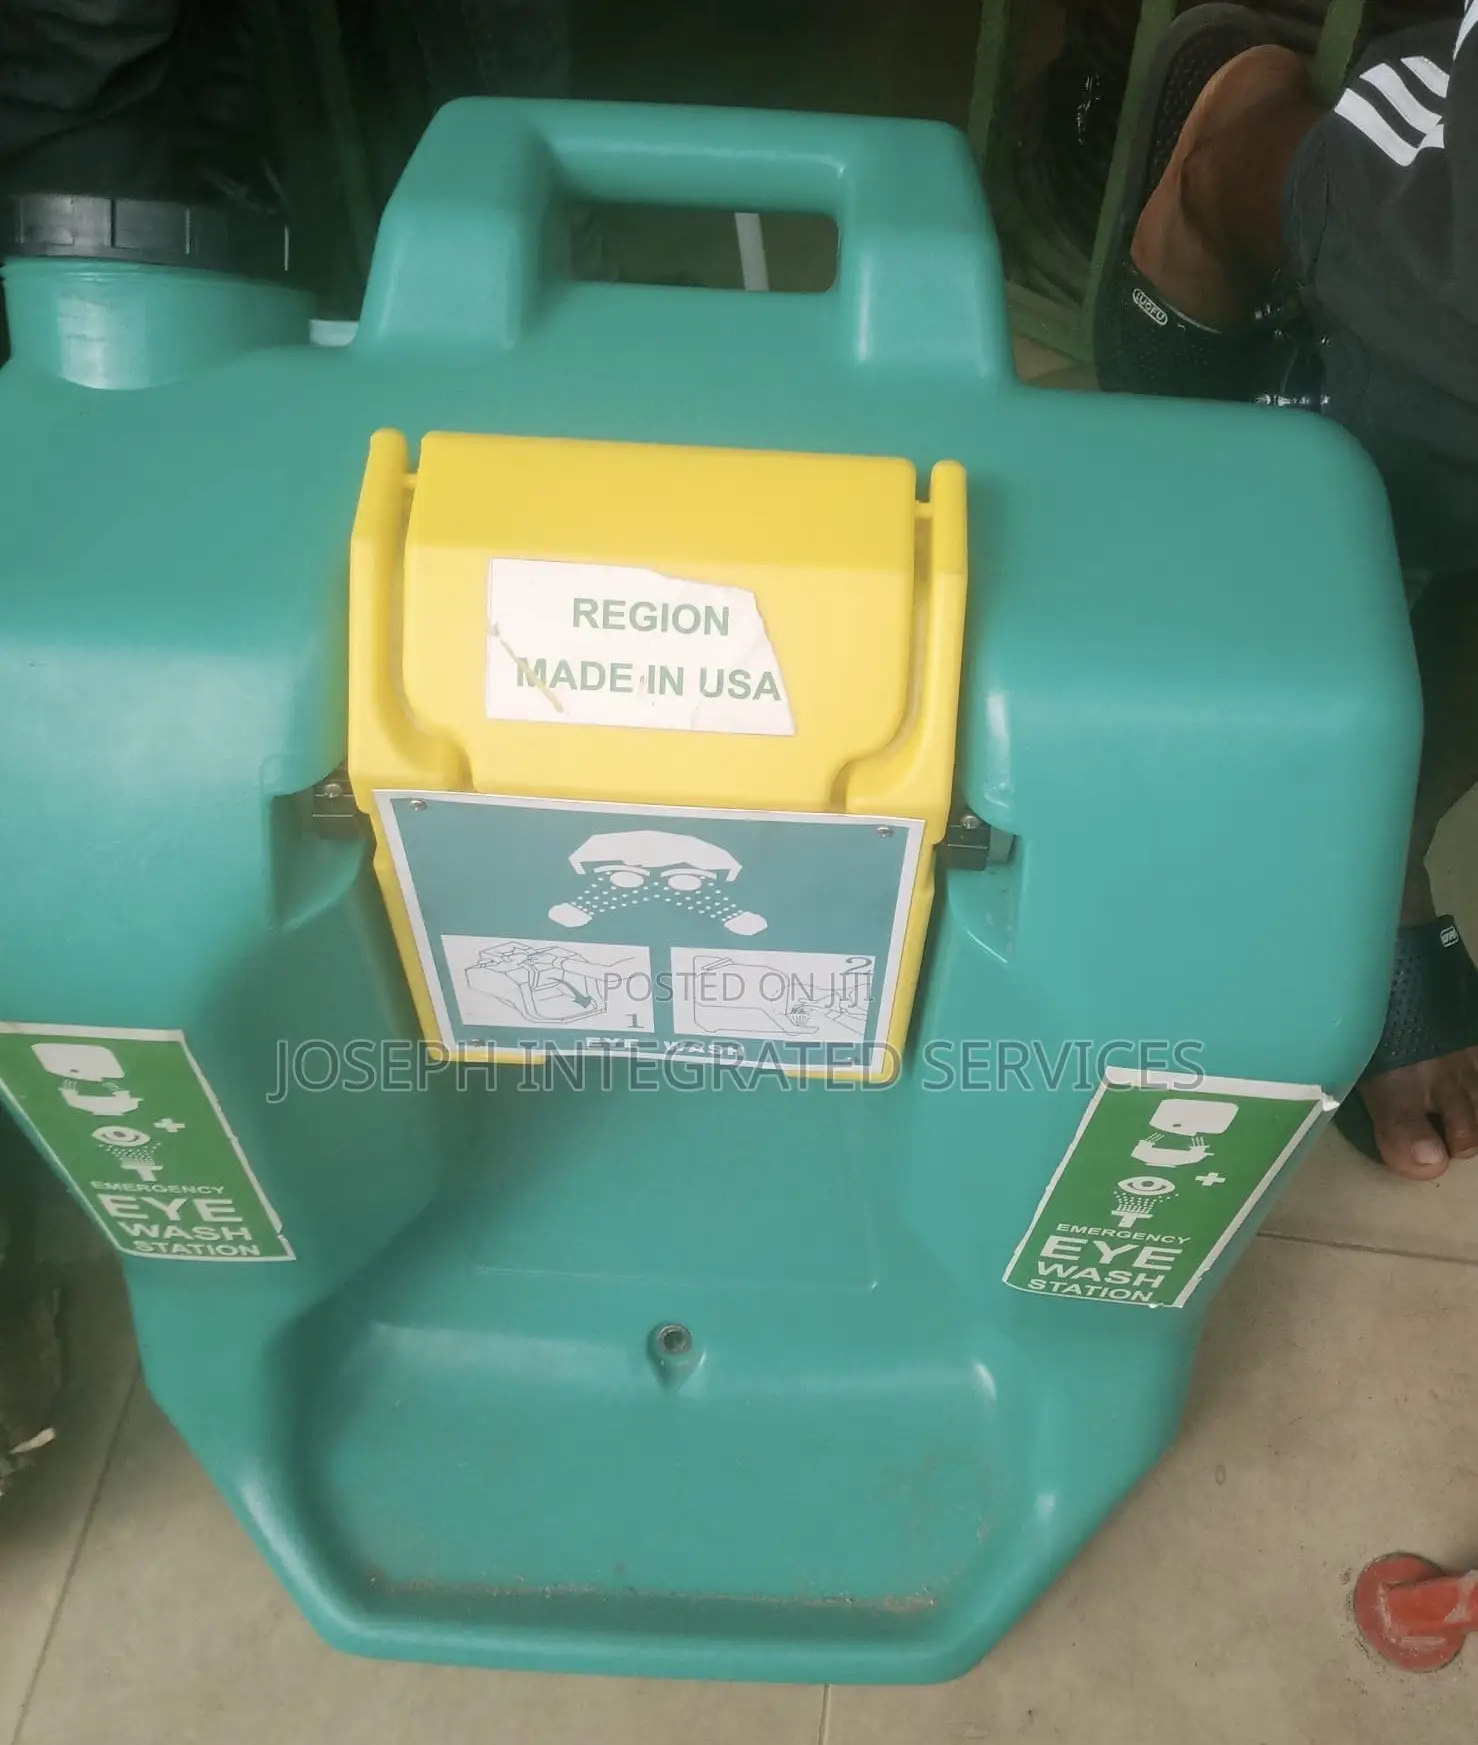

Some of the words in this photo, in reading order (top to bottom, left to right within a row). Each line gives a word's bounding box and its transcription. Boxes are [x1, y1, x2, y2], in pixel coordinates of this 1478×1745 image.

[573, 597, 729, 636] REGION
[517, 657, 633, 693] MADE
[647, 665, 684, 696] IN
[699, 668, 781, 701] USA
[844, 957, 873, 975] 2
[626, 1013, 645, 1029] 1
[90, 1180, 225, 1195] EMERGENCY
[97, 1193, 244, 1222] EYE
[117, 1221, 253, 1241] WASH
[1056, 1222, 1192, 1245] EMERGENCY
[132, 1240, 261, 1257] STATION
[1039, 1235, 1184, 1271] EYE
[1036, 1261, 1166, 1289] WASH
[1027, 1278, 1154, 1302] STATION
